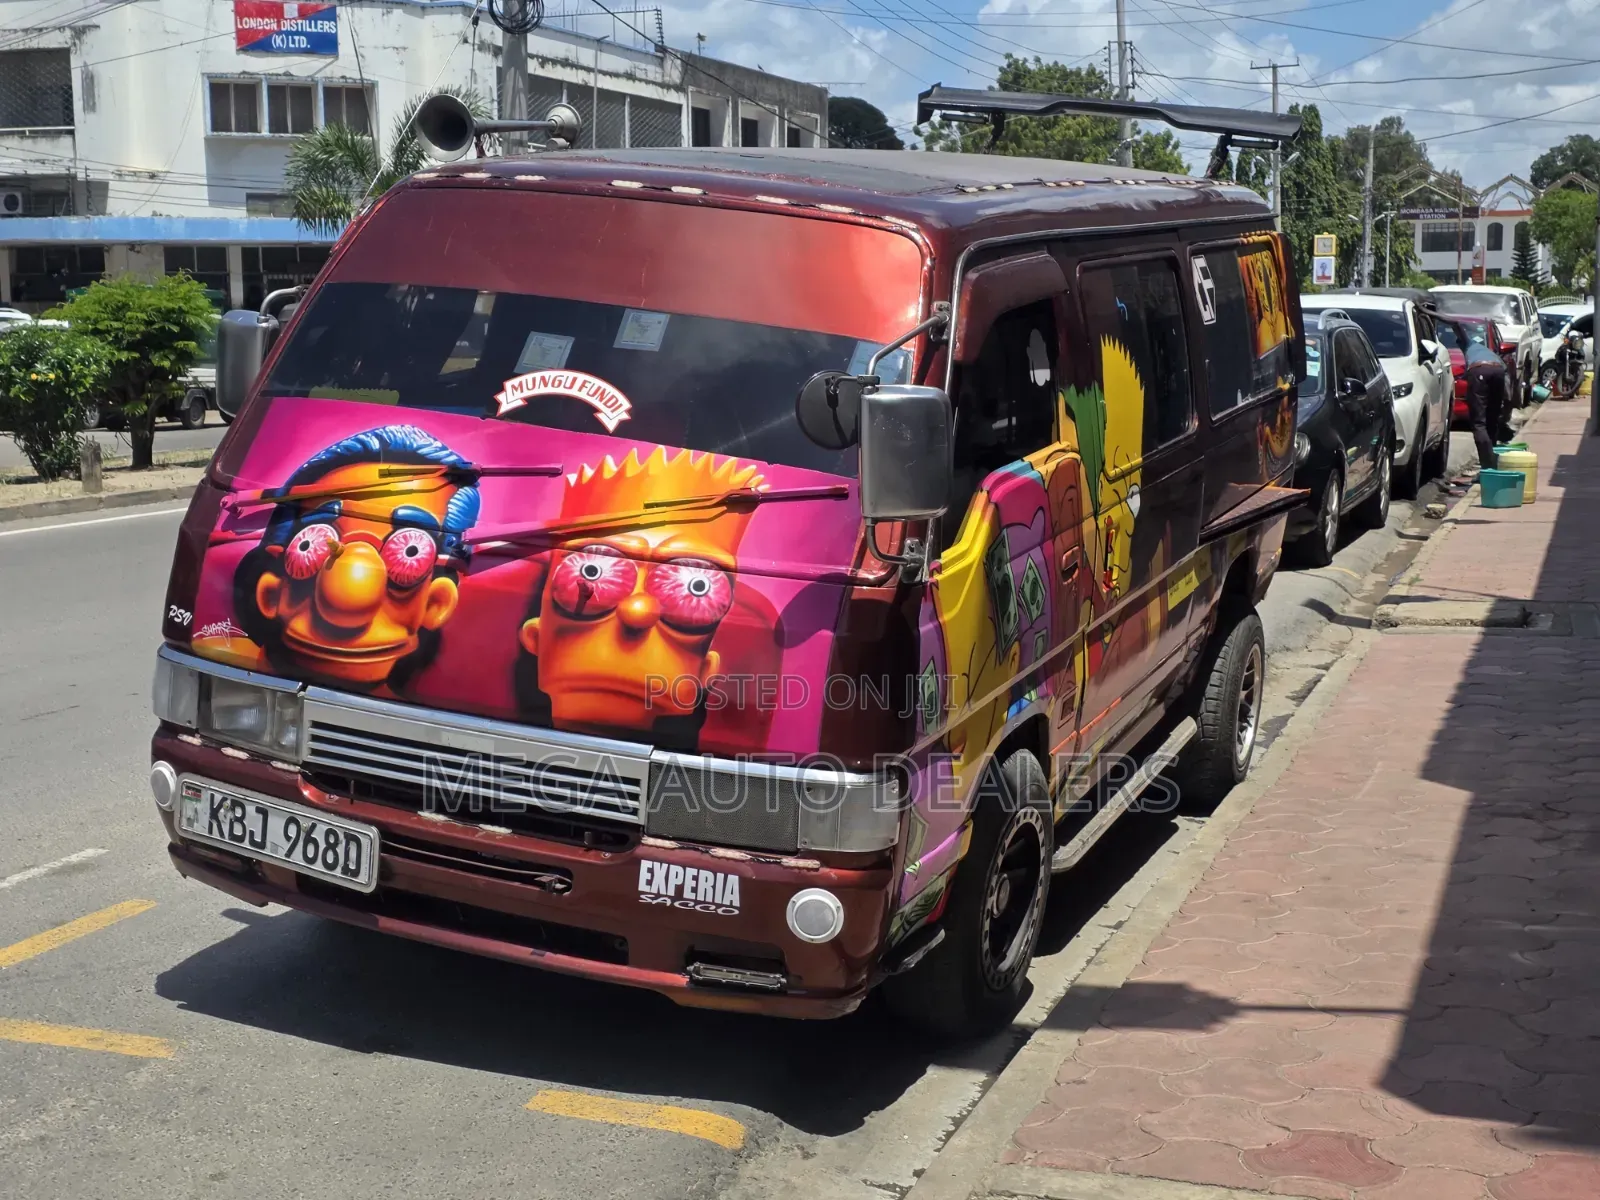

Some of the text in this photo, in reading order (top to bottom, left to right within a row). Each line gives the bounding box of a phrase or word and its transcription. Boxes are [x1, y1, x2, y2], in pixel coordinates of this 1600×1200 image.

[236, 16, 337, 33] LONDON DISTILLERS
[271, 34, 311, 48] (K) LTD.
[510, 375, 624, 414] MUNGU FUNDI
[168, 604, 193, 626] PSV
[207, 792, 269, 851] KBJ
[283, 814, 363, 878] 968D
[638, 859, 741, 908] EXPERIA
[638, 894, 740, 916] SACCO
